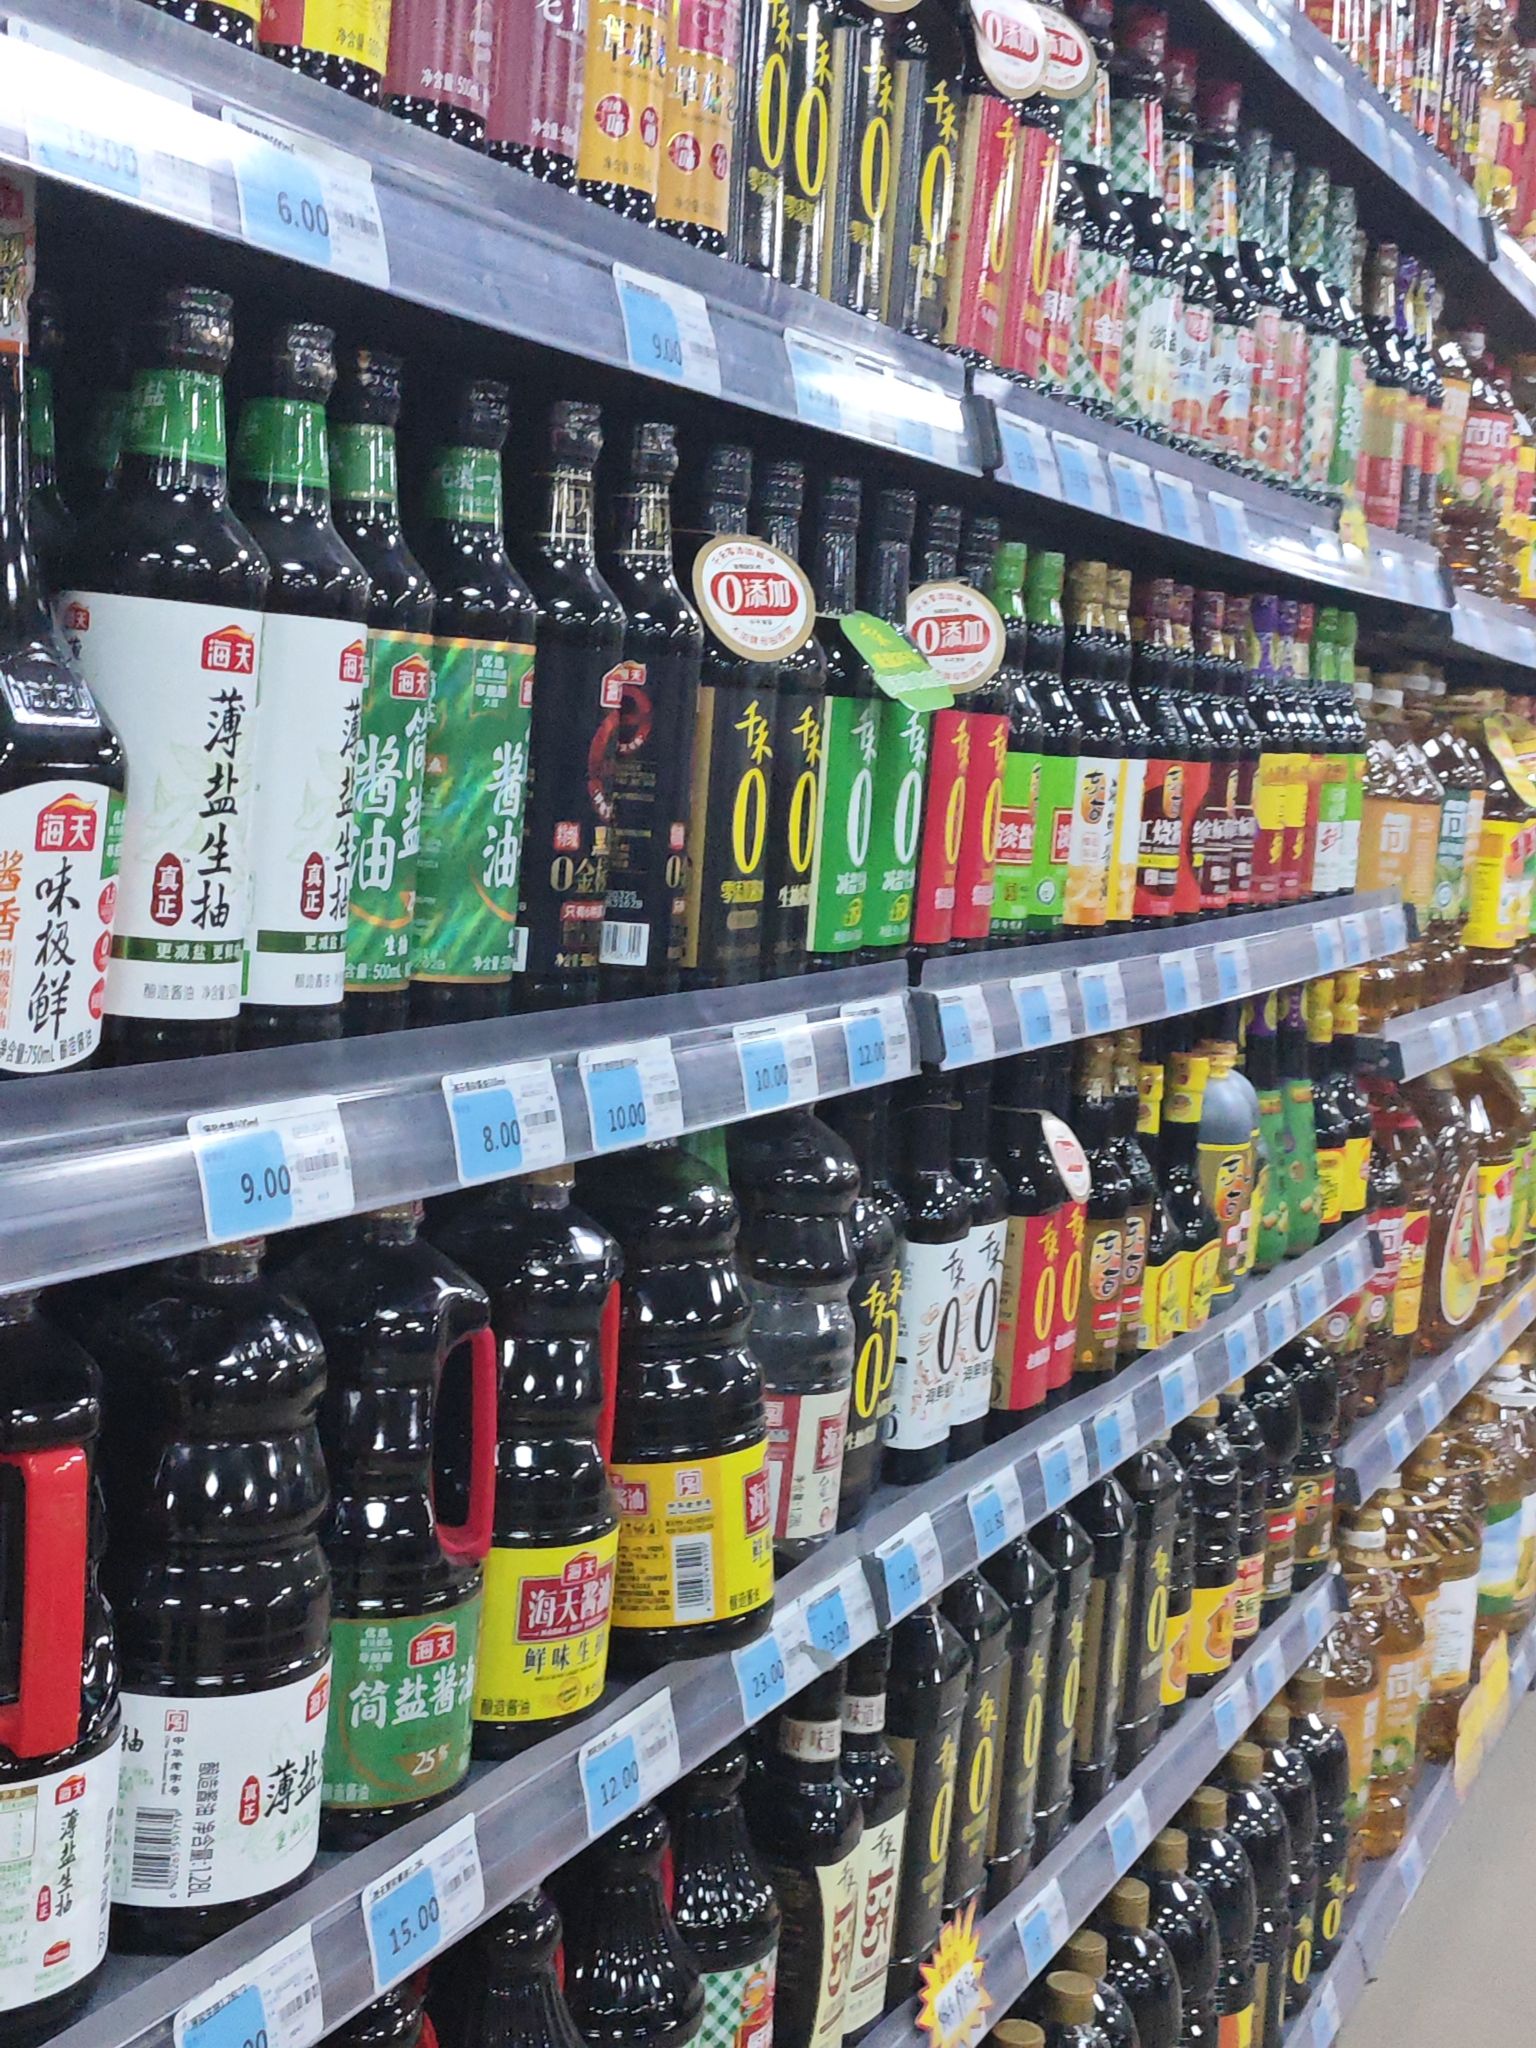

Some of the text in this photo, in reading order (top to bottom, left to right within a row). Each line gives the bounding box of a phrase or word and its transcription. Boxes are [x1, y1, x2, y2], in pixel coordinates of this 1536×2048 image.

[277, 190, 330, 238] 6.00
[651, 334, 683, 367] 9.00
[717, 574, 792, 613] 0添加
[207, 637, 253, 670] 海天
[916, 619, 985, 655] 0添加
[398, 671, 429, 697] 海天
[734, 700, 774, 765] 千禾
[791, 705, 822, 768] 千禾
[900, 711, 927, 768] 千禾
[41, 813, 92, 847] 海天
[191, 687, 245, 931] 薄盐生抽
[351, 734, 402, 892] 酱油
[484, 741, 527, 888] 酱油
[732, 768, 767, 874] 0
[788, 771, 818, 873] 0
[847, 768, 873, 868] 0
[894, 768, 923, 865] 0
[945, 776, 966, 865] 0
[154, 865, 182, 920] 真正
[304, 863, 324, 914] 真正
[28, 855, 81, 1040] 味极鲜
[755, 1063, 789, 1092] 10.00
[482, 1119, 521, 1153] 8.00
[608, 1101, 647, 1133] 10.00
[240, 1163, 292, 1205] 9.00
[942, 1247, 966, 1290] 千禾
[978, 1229, 1005, 1271] 千禾
[1038, 1220, 1060, 1262] 千禾
[859, 1279, 888, 1330] 千禾
[1034, 1265, 1056, 1341] 0
[1061, 1250, 1083, 1323] 0
[937, 1296, 960, 1375] 0
[974, 1277, 998, 1353] 0
[855, 1332, 884, 1419] 0
[567, 1560, 597, 1582] 海天
[527, 1572, 612, 1630] 海天酱油
[414, 1635, 451, 1662] 海天
[752, 1659, 785, 1699] 23.00
[58, 1781, 86, 1801] 海天
[168, 1735, 185, 1797] 中华老字号
[194, 1761, 220, 1817] 酿造酱油
[263, 1750, 322, 1819] 薄盐
[600, 1759, 639, 1807] 12.00
[968, 1735, 993, 1815] 0
[241, 1783, 260, 1821] 真正
[929, 1782, 953, 1864] 0
[55, 1807, 80, 1918] 薄盐生抽
[388, 1896, 440, 1956] 15.00
